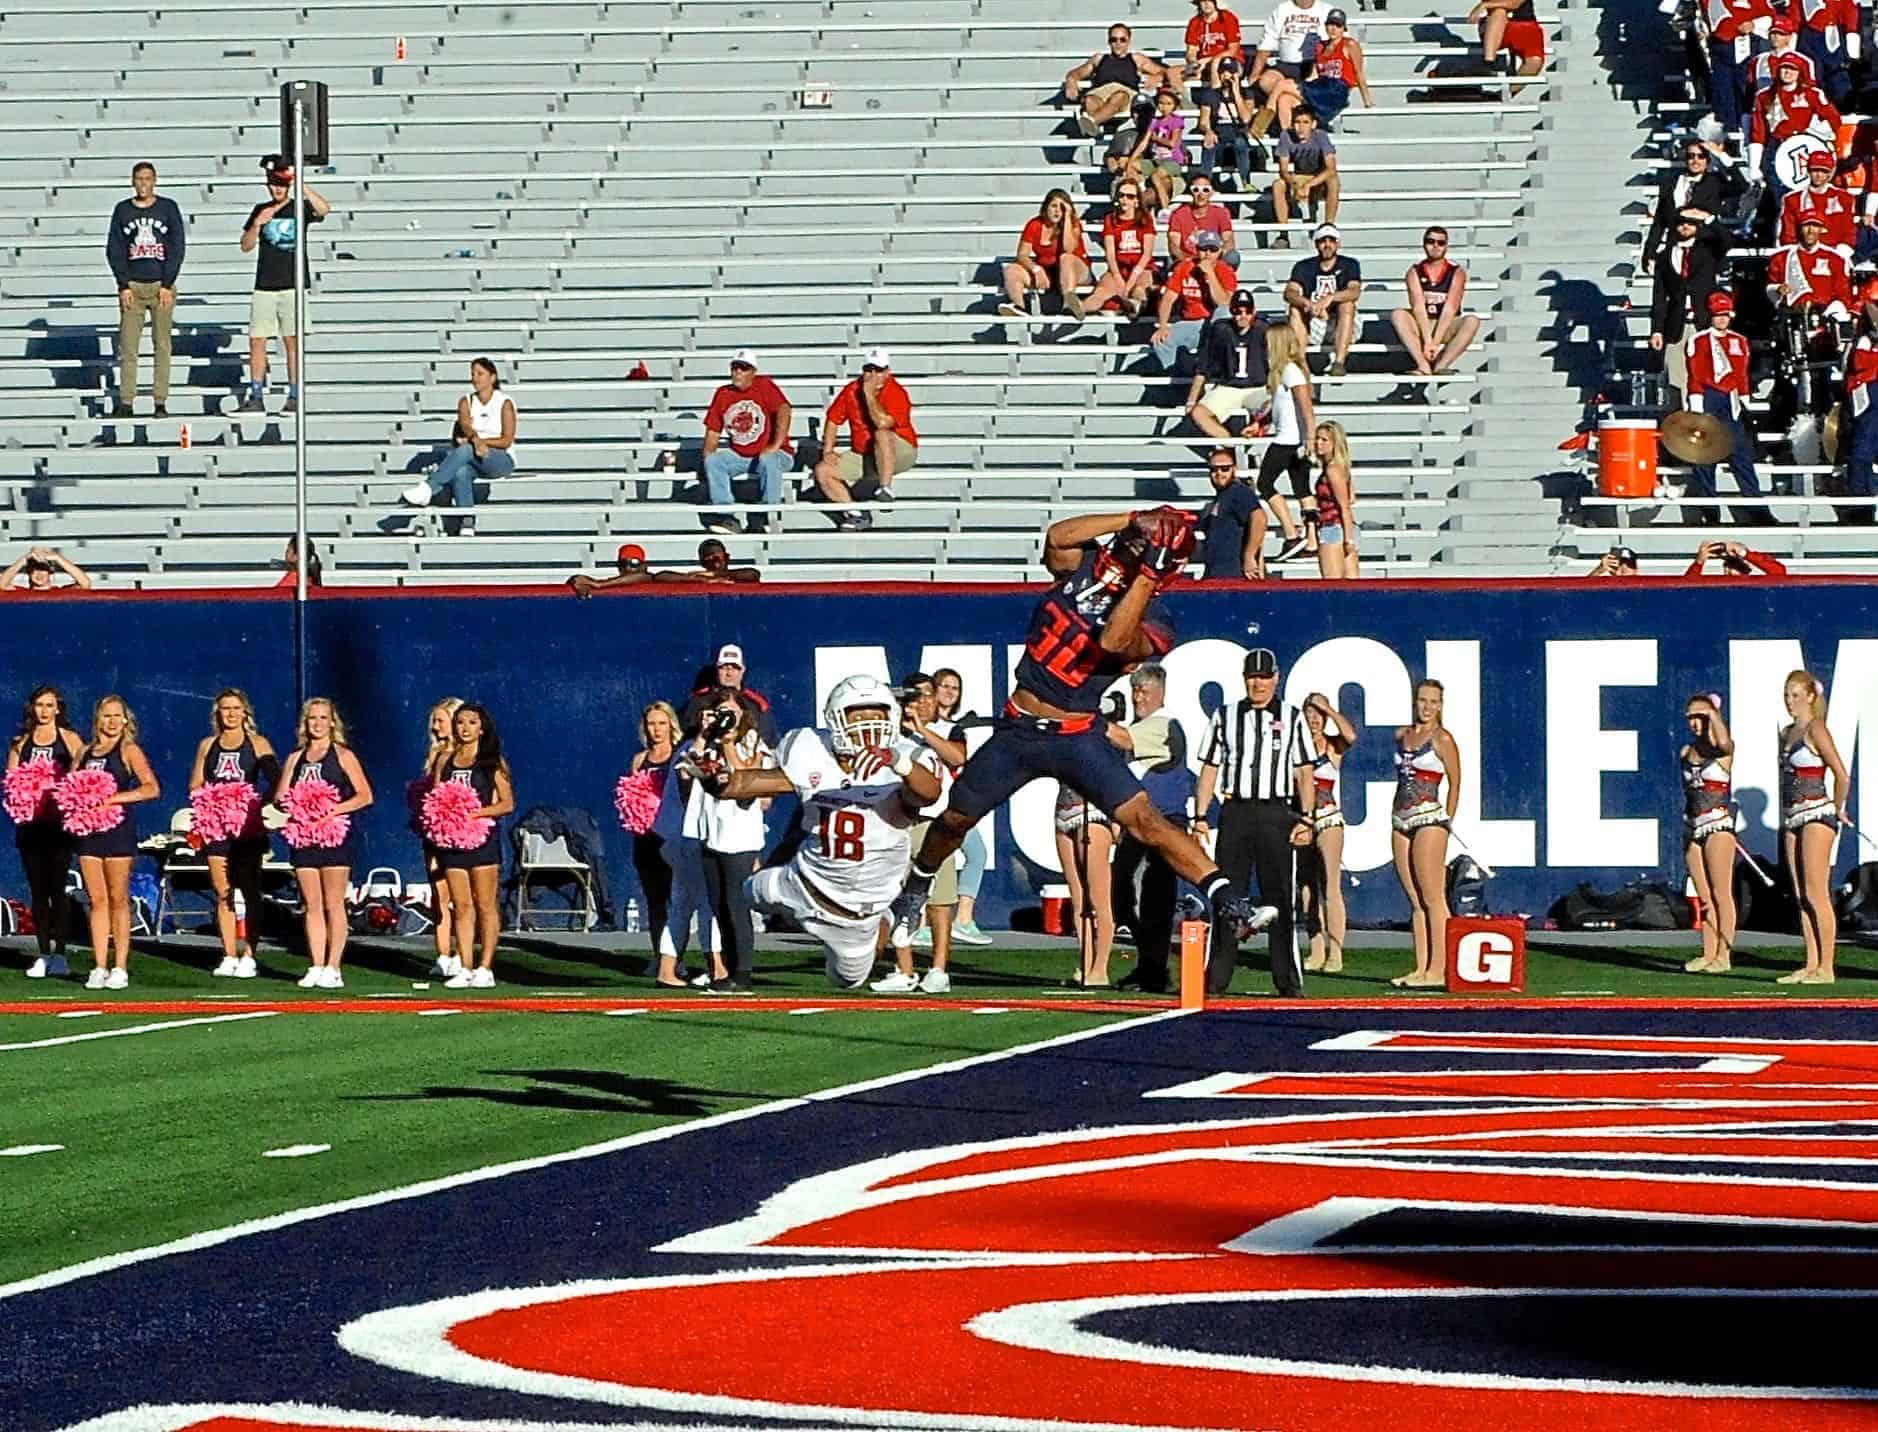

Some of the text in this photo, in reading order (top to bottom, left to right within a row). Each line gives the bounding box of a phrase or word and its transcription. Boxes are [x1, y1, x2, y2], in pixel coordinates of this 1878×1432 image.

[1235, 347, 1249, 378] 1
[213, 752, 245, 782] A
[815, 636, 1658, 873] MSCLE
[820, 811, 865, 862] 18
[1457, 931, 1514, 983] G
